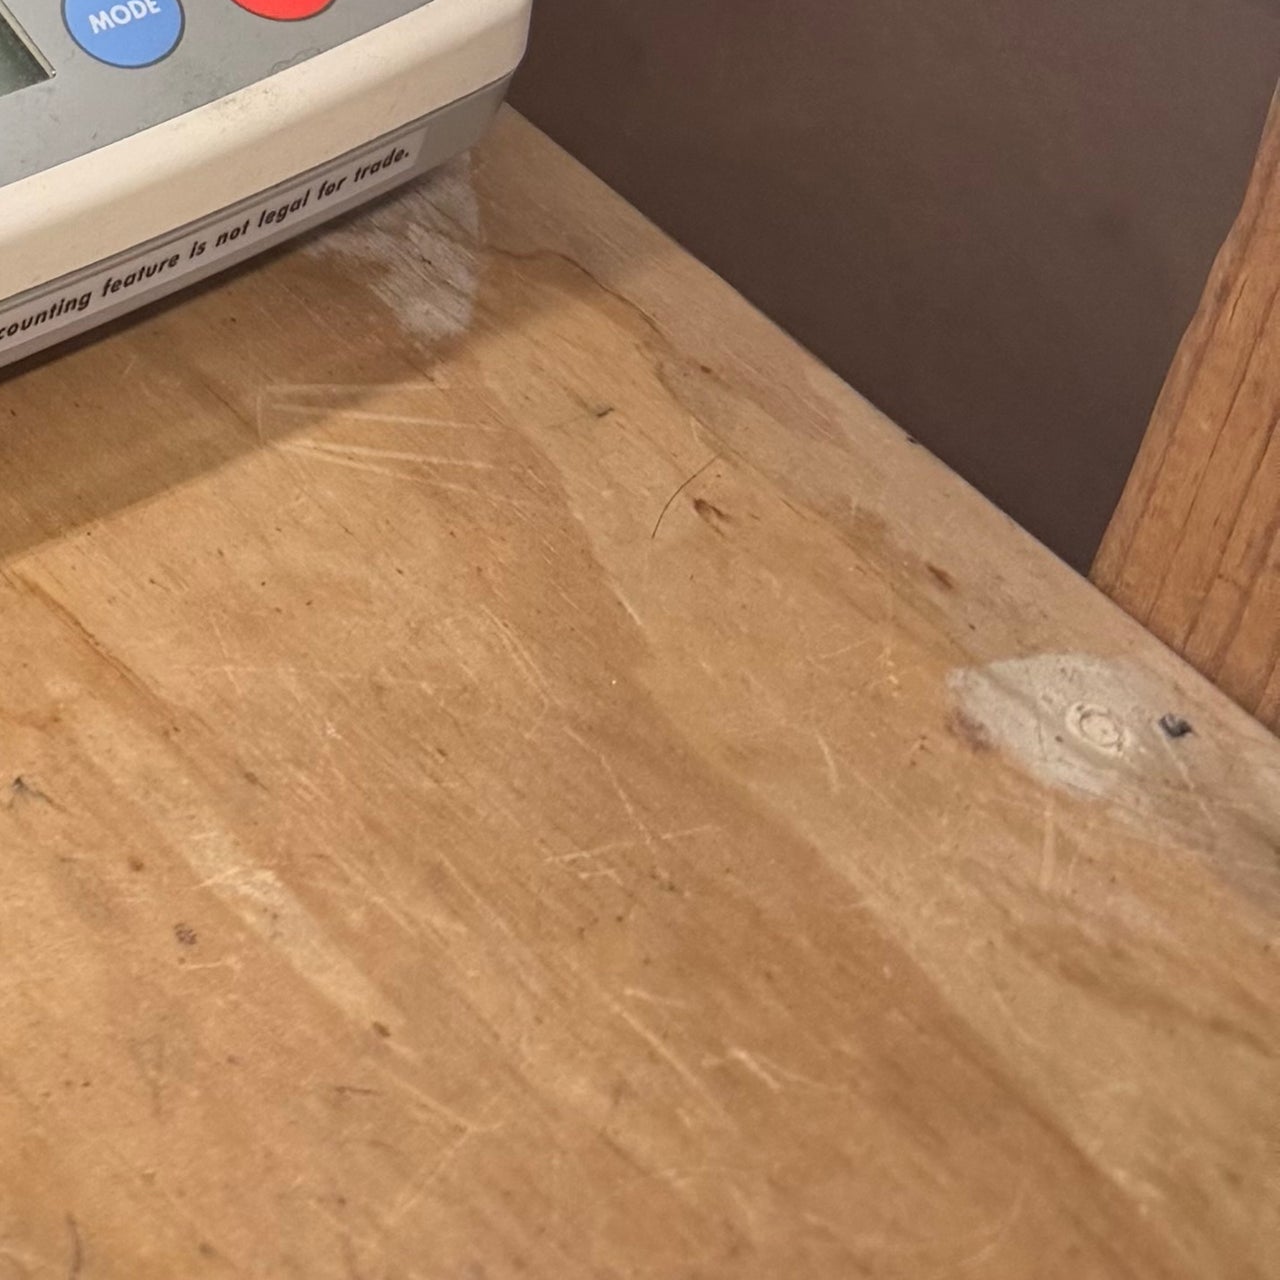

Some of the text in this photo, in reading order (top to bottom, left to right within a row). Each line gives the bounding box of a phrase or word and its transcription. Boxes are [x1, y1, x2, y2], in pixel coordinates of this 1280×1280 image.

[101, 253, 180, 298] feature
[189, 240, 207, 260] is
[215, 218, 250, 248] not
[257, 189, 311, 229] legal
[317, 177, 346, 201] for
[353, 146, 410, 183] trade.
